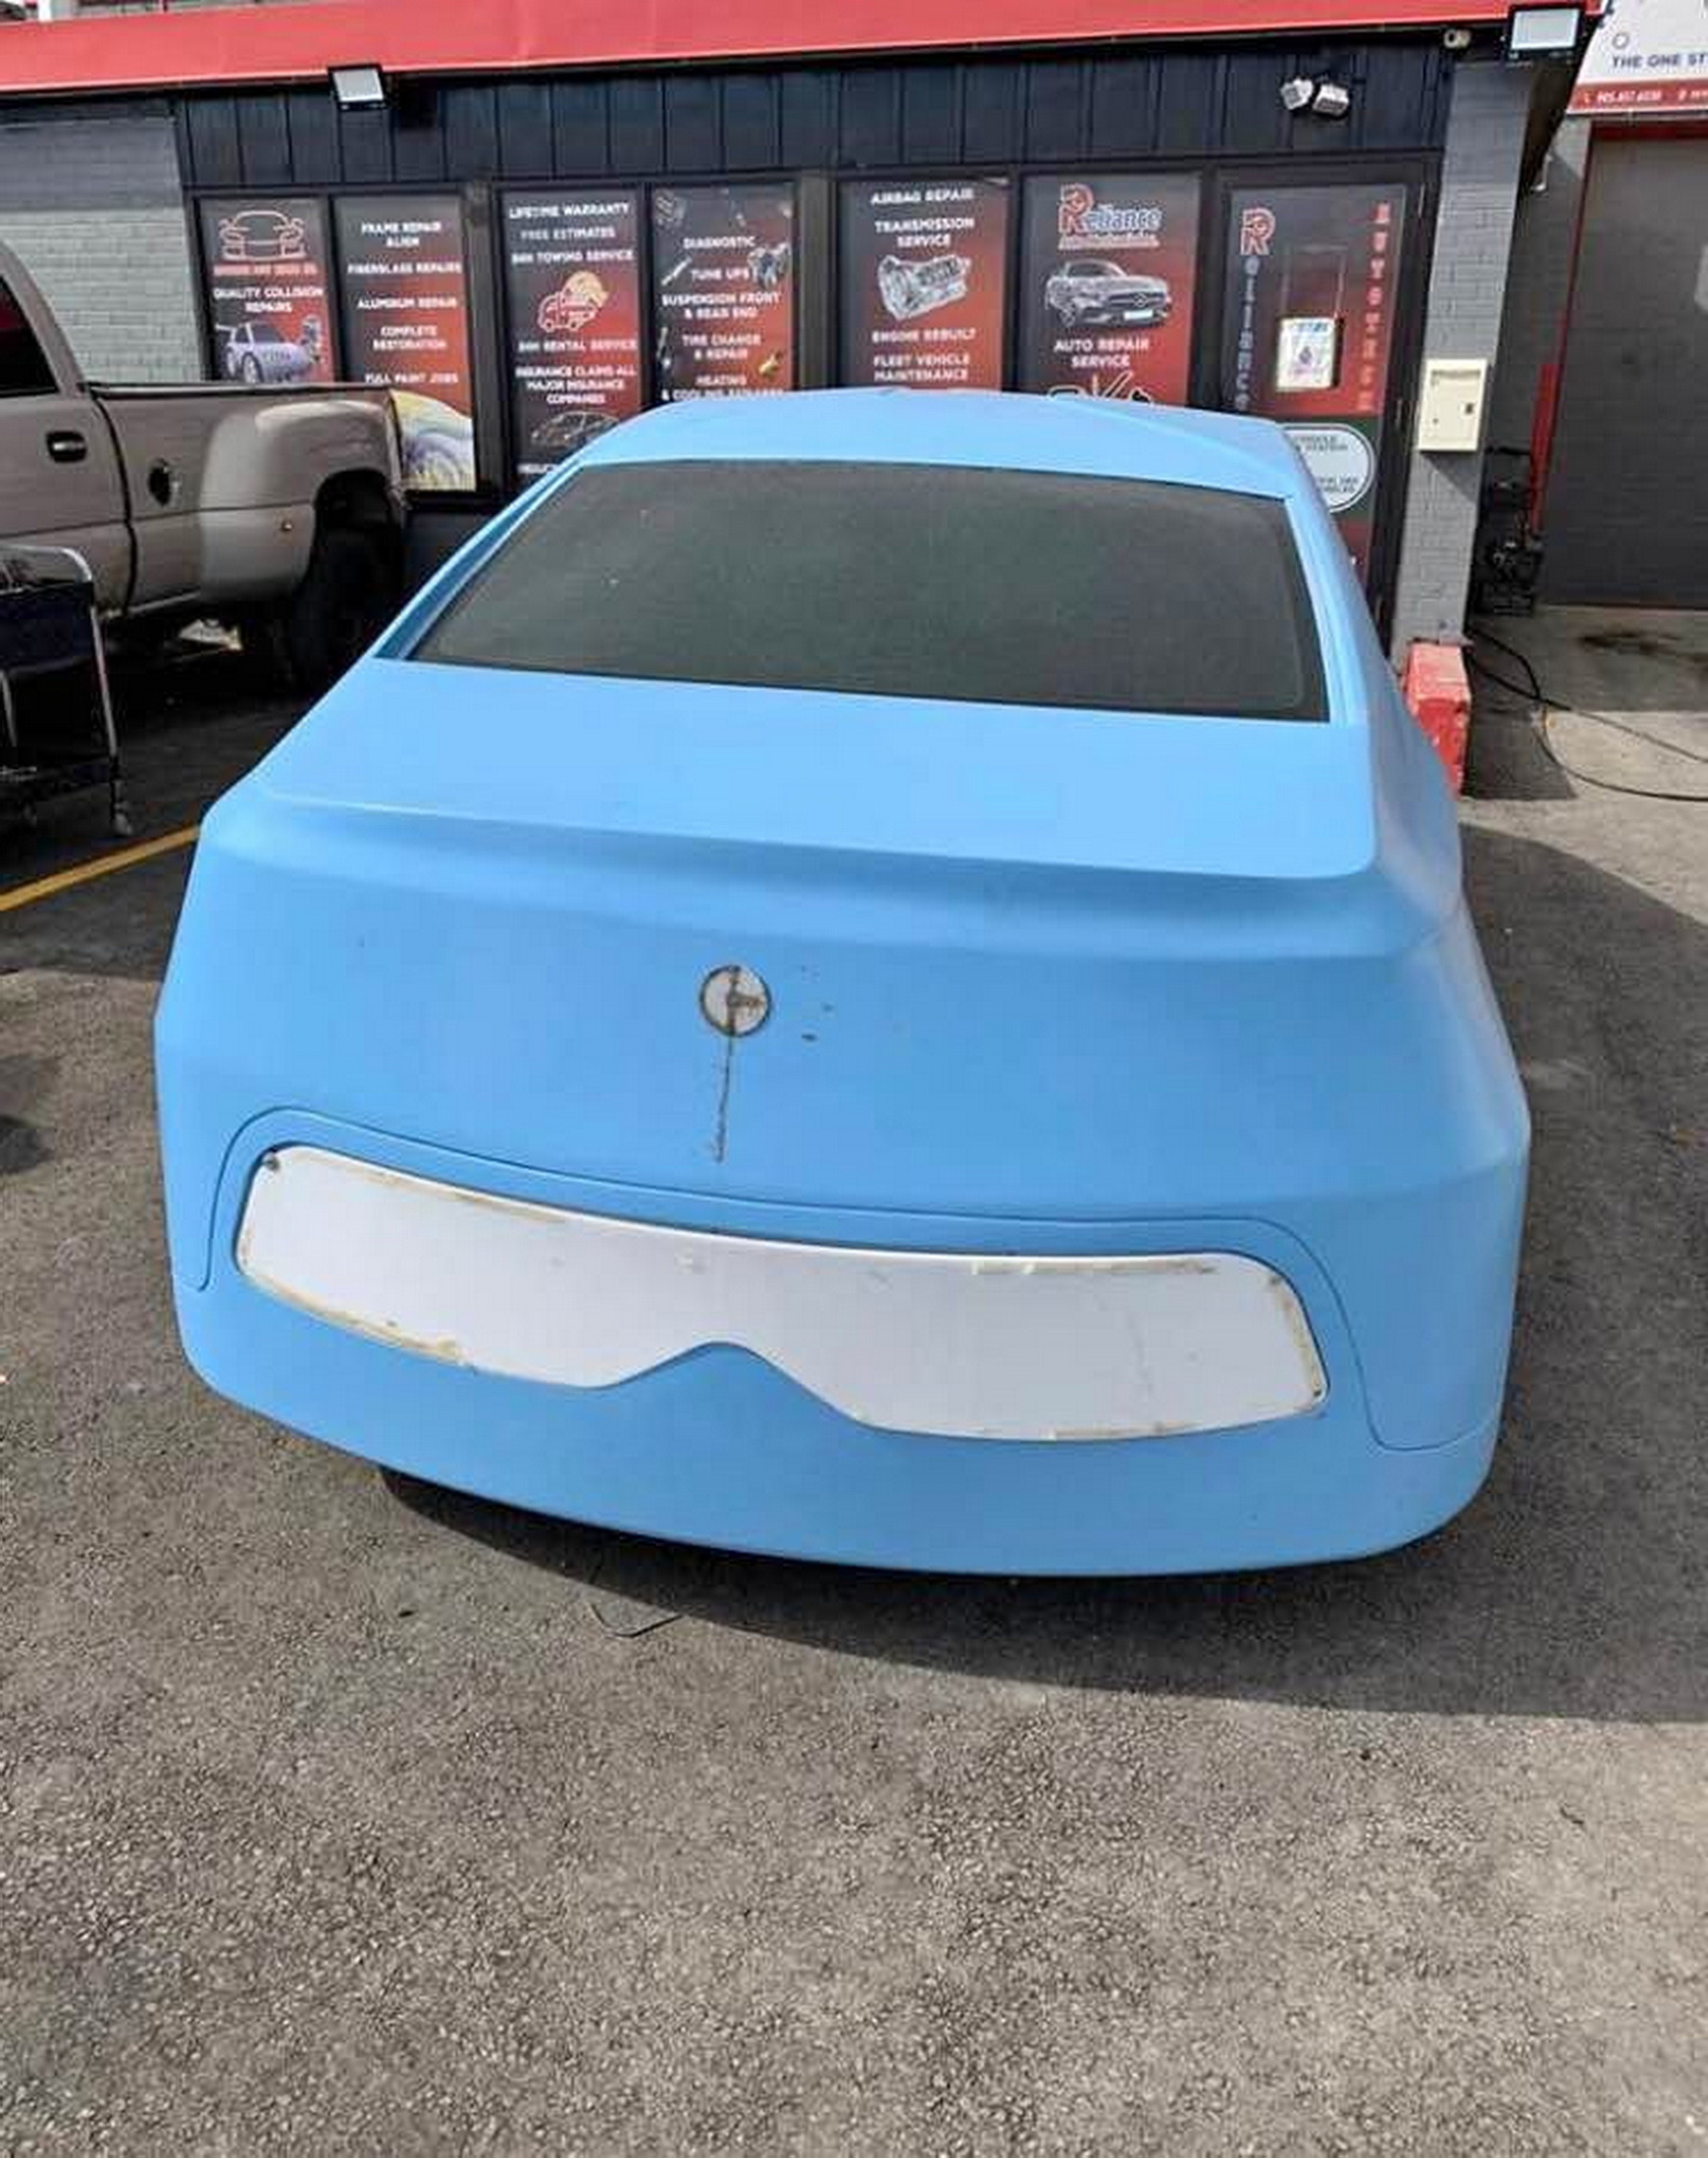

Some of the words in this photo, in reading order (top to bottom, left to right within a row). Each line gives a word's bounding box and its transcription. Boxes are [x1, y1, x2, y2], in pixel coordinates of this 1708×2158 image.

[1613, 55, 1642, 68] THE
[1647, 54, 1681, 67] ONE
[870, 191, 922, 205] AIRBAG
[924, 187, 975, 202] REPAIR
[508, 205, 560, 220] LIFETIME
[562, 202, 630, 216] WARRANTY
[1058, 182, 1164, 233] Reliance
[874, 217, 976, 233] TRANSMISSION
[520, 230, 548, 240] FREE
[552, 227, 616, 239] ESTIMATES
[897, 233, 952, 248] SERVICE
[683, 235, 756, 249] DIAGNOSTIC
[536, 250, 584, 263] TOWING
[586, 249, 635, 262] SERVICE
[346, 263, 414, 275] FIBERGLASS
[416, 261, 463, 275] REPAIRS
[691, 269, 722, 281] TUNE
[726, 268, 751, 281] UPS
[214, 288, 261, 300] QUALITY
[263, 286, 325, 298] COLLISION
[661, 293, 737, 307] SUSPENSION
[739, 291, 781, 305] FRONT
[245, 301, 293, 313] REPAIRS
[356, 297, 415, 310] ALUMINUM
[696, 307, 730, 320] REAR
[733, 306, 759, 319] END
[381, 326, 439, 336] COMPLETE
[871, 330, 920, 343] ENGINE
[373, 338, 448, 351] RESTORATION
[543, 340, 586, 352] RENTAL
[590, 338, 638, 351] SERVICE
[682, 334, 708, 347] TIRE
[710, 334, 761, 346] CHANGE
[1053, 338, 1094, 353] AUTO
[1098, 337, 1150, 351] REPAIR
[705, 348, 749, 360] REPAIR
[872, 353, 912, 367] FLEET
[915, 352, 970, 366] VEHICLE
[1071, 354, 1131, 369] SERVICE
[515, 366, 573, 378] INSURANCE
[574, 365, 614, 377] CLAIMS
[616, 364, 637, 377] ALL
[873, 368, 969, 382] MAINTENANCE
[364, 373, 391, 384] FULL
[526, 380, 566, 391] MAJOR
[566, 379, 626, 390] INSURANCE
[695, 373, 749, 386] HEATING
[545, 393, 607, 405] COMPANIES
